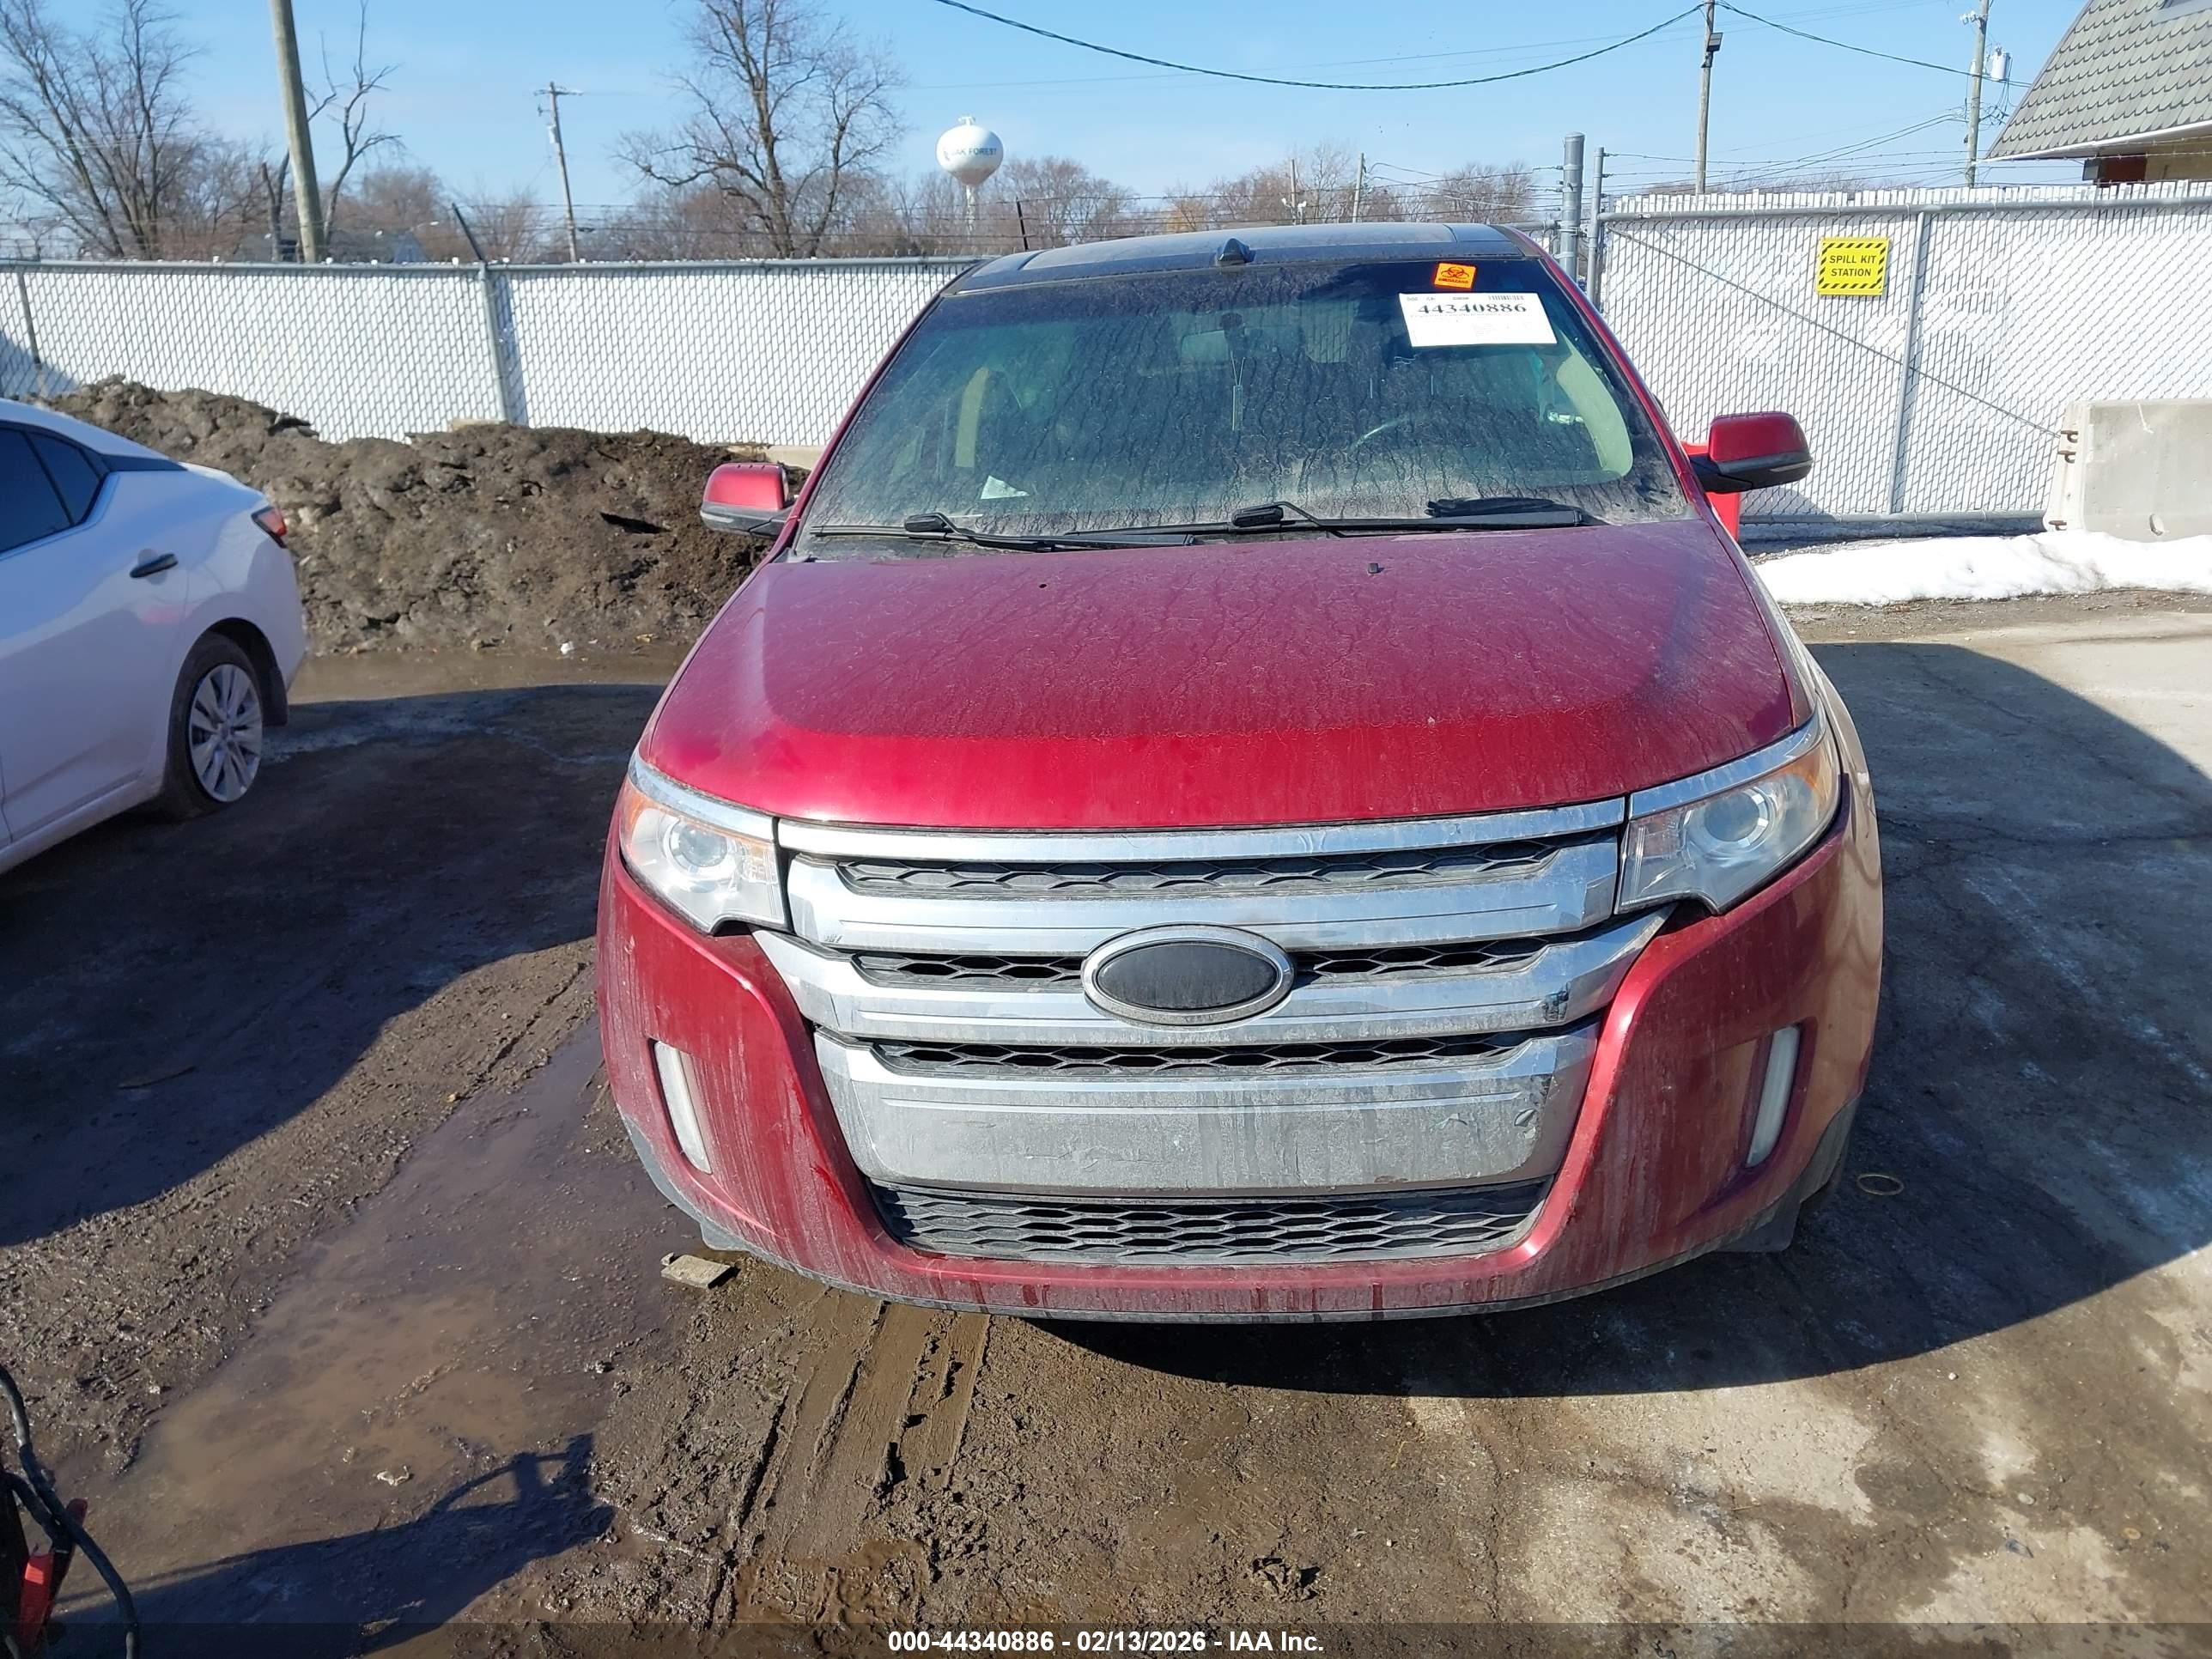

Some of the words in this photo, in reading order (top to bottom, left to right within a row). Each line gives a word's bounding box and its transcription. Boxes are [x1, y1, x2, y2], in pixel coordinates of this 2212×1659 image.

[1829, 255, 1856, 264] SPILL
[1860, 255, 1876, 264] KIT
[1831, 268, 1871, 276] STATION
[1418, 303, 1526, 313] 44340886
